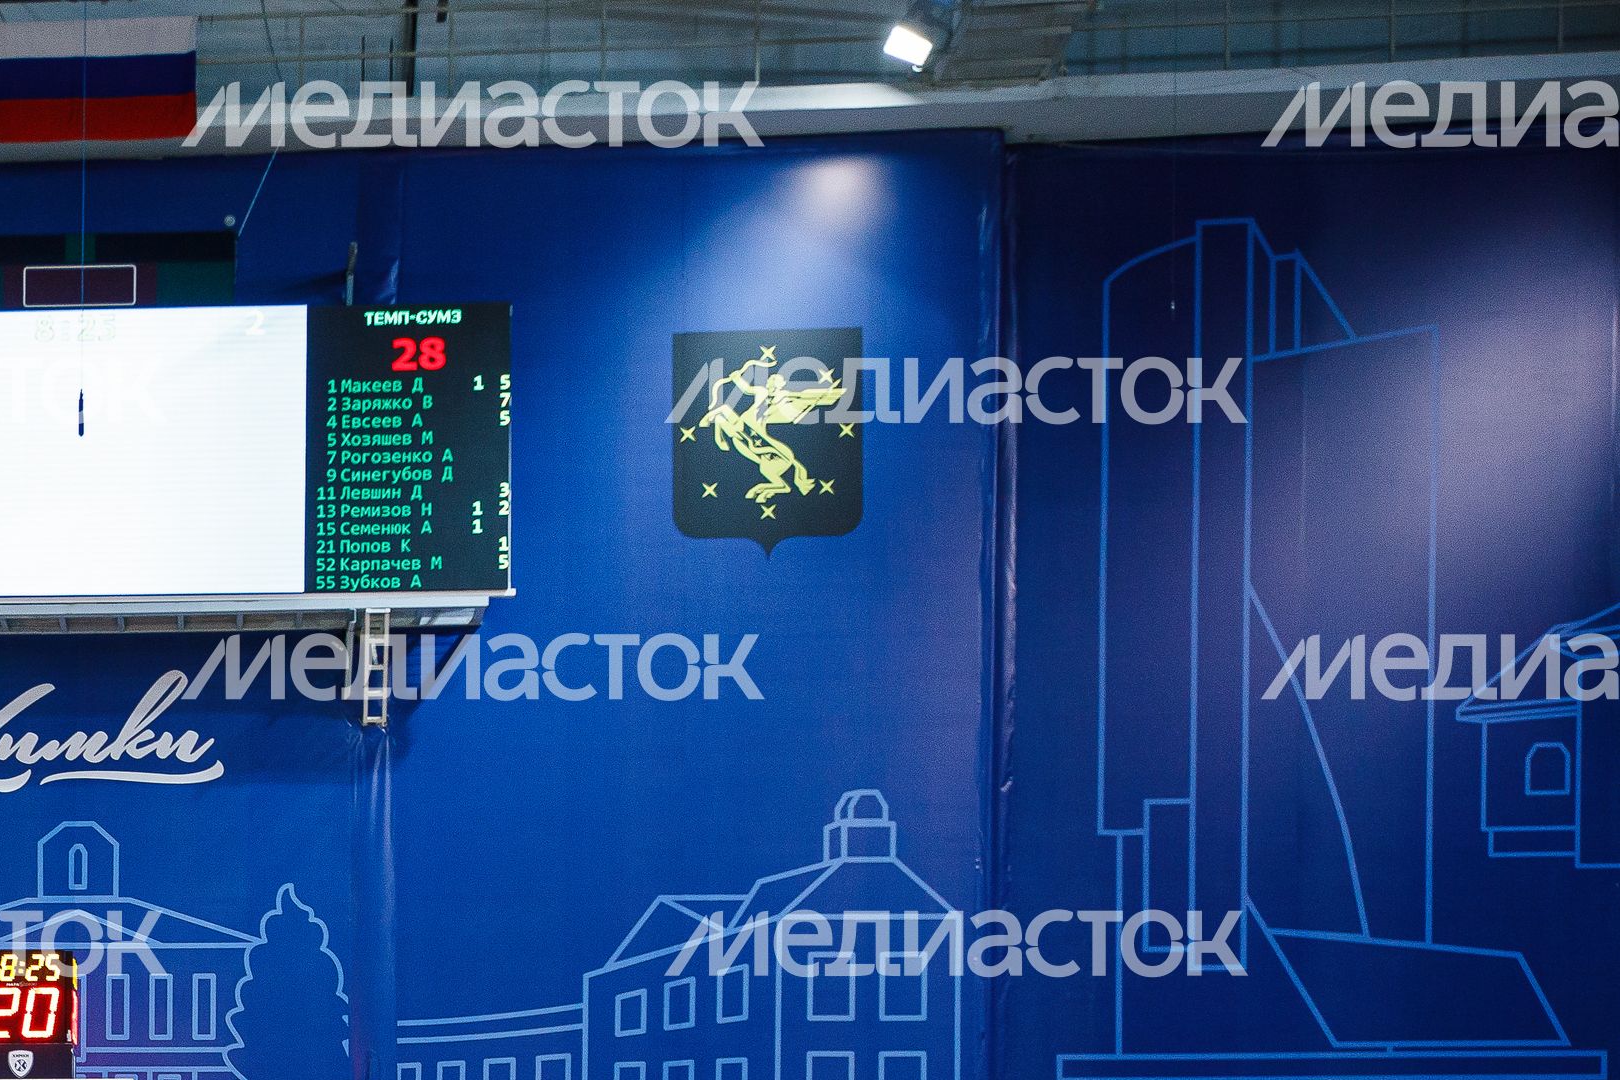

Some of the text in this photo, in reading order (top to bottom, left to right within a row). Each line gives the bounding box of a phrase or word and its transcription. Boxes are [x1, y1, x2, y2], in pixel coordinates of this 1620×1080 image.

[391, 336, 447, 371] 28
[329, 374, 510, 393] 1 Макеев Д 1 5
[327, 393, 511, 413] 2 Заряжко В 7
[326, 411, 510, 429] 4 Евсеев А 5
[327, 432, 433, 447] 5 Хозяшев М
[327, 449, 453, 465] 7 Рогозенко А
[327, 466, 453, 483] 9 Синегубов Д
[317, 482, 510, 501] 11 Левшин Д 3
[316, 501, 510, 518] 13 Ремизов Н 1 2
[316, 519, 483, 536] 15 Семенюк А 1
[316, 537, 509, 554] 21 Попов К 1
[316, 555, 509, 574] 52 Карпачев М 5
[316, 575, 422, 591] 55 Зубков А
